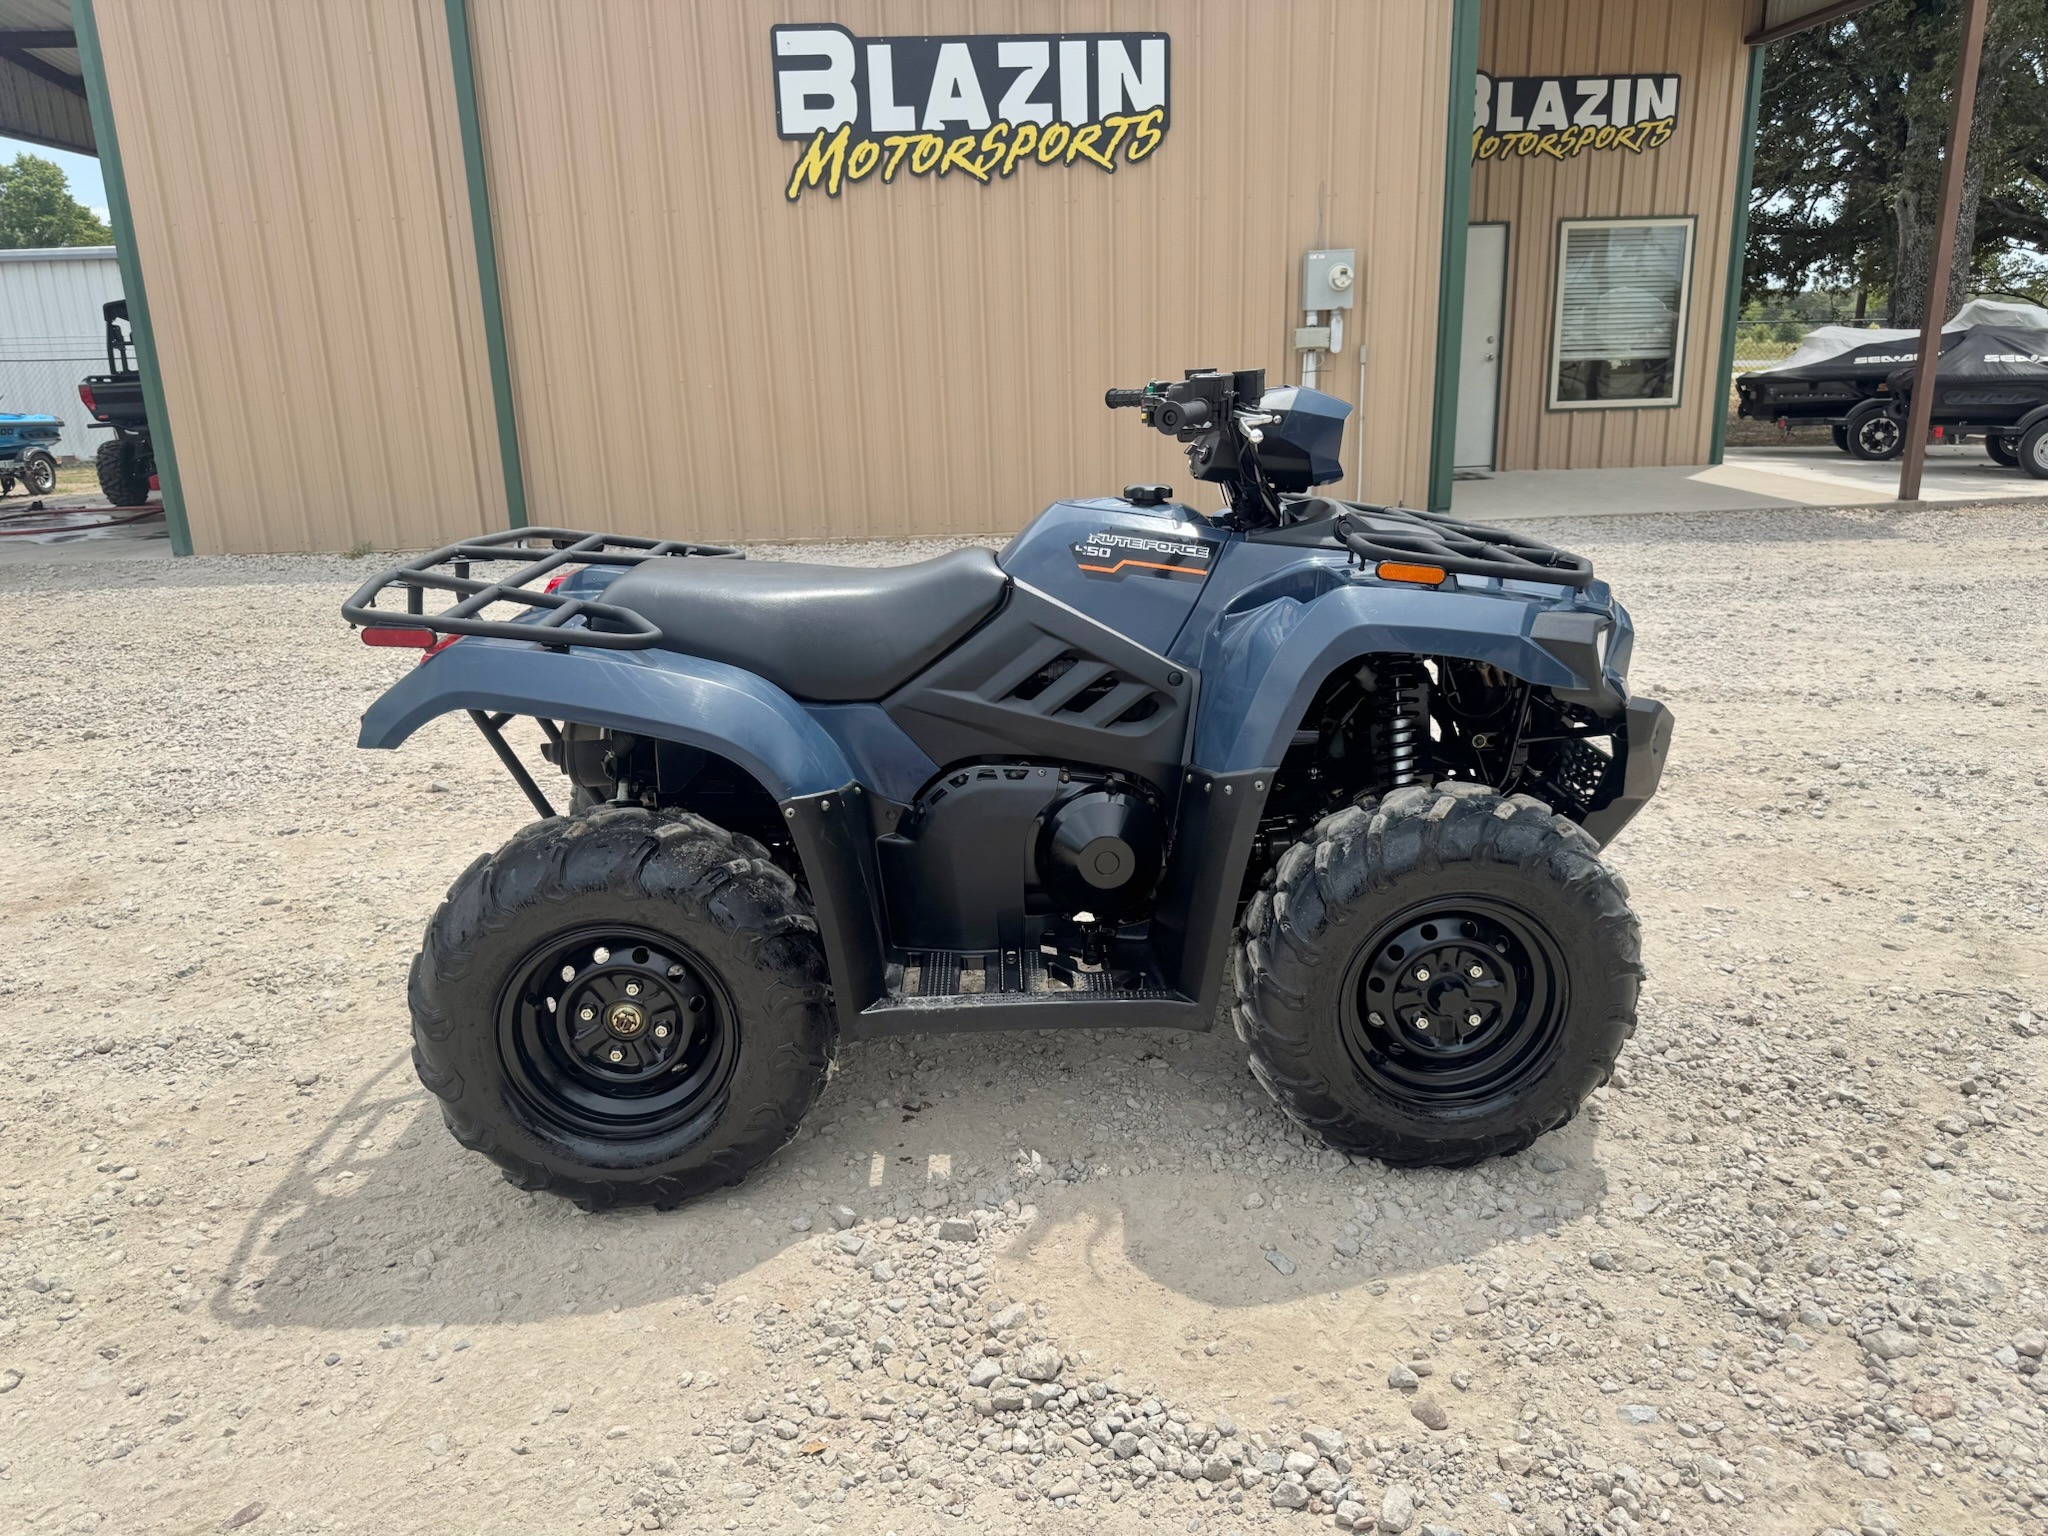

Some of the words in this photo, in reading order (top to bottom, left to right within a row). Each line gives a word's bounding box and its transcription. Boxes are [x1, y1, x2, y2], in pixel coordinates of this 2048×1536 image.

[776, 30, 1165, 134] BLAZIN
[788, 109, 1164, 198] MOTORSPORTS
[1086, 533, 1144, 550] RUTE
[1142, 539, 1210, 559] FORCE
